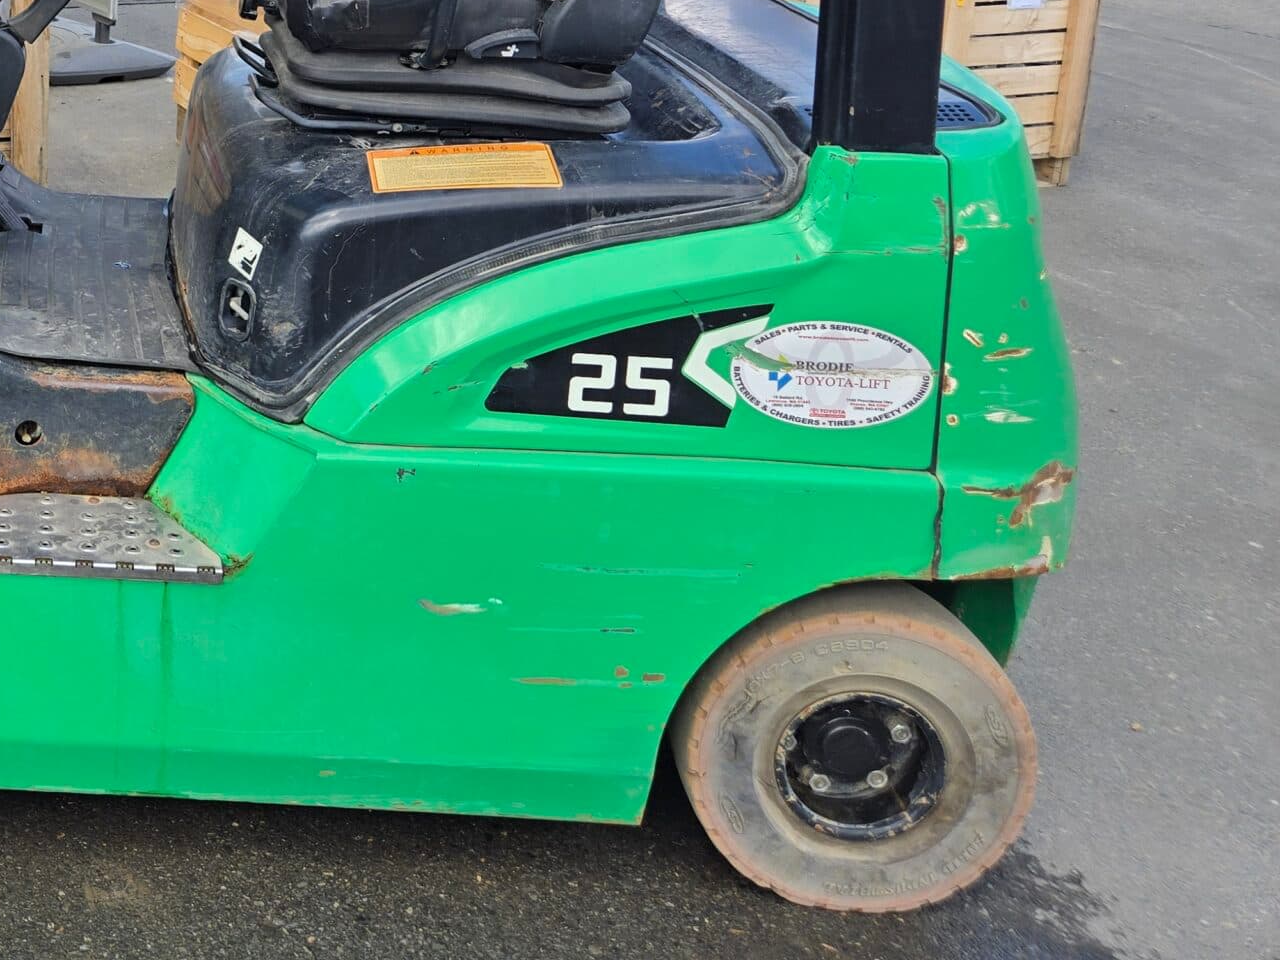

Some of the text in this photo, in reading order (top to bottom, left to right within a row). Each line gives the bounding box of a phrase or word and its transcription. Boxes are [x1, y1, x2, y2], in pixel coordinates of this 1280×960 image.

[426, 145, 510, 155] WARNING
[754, 329, 782, 345] SALES
[787, 323, 818, 333] PARTS
[830, 324, 870, 335] SERVICE
[875, 332, 913, 354] RENTALS
[566, 352, 673, 417] 25
[733, 365, 761, 407] BATTERIES
[769, 408, 820, 426] CHARGERS
[865, 407, 902, 424] SAFETY
[901, 375, 930, 410] TRAINING
[795, 375, 891, 389] TOYOTA-LIFT
